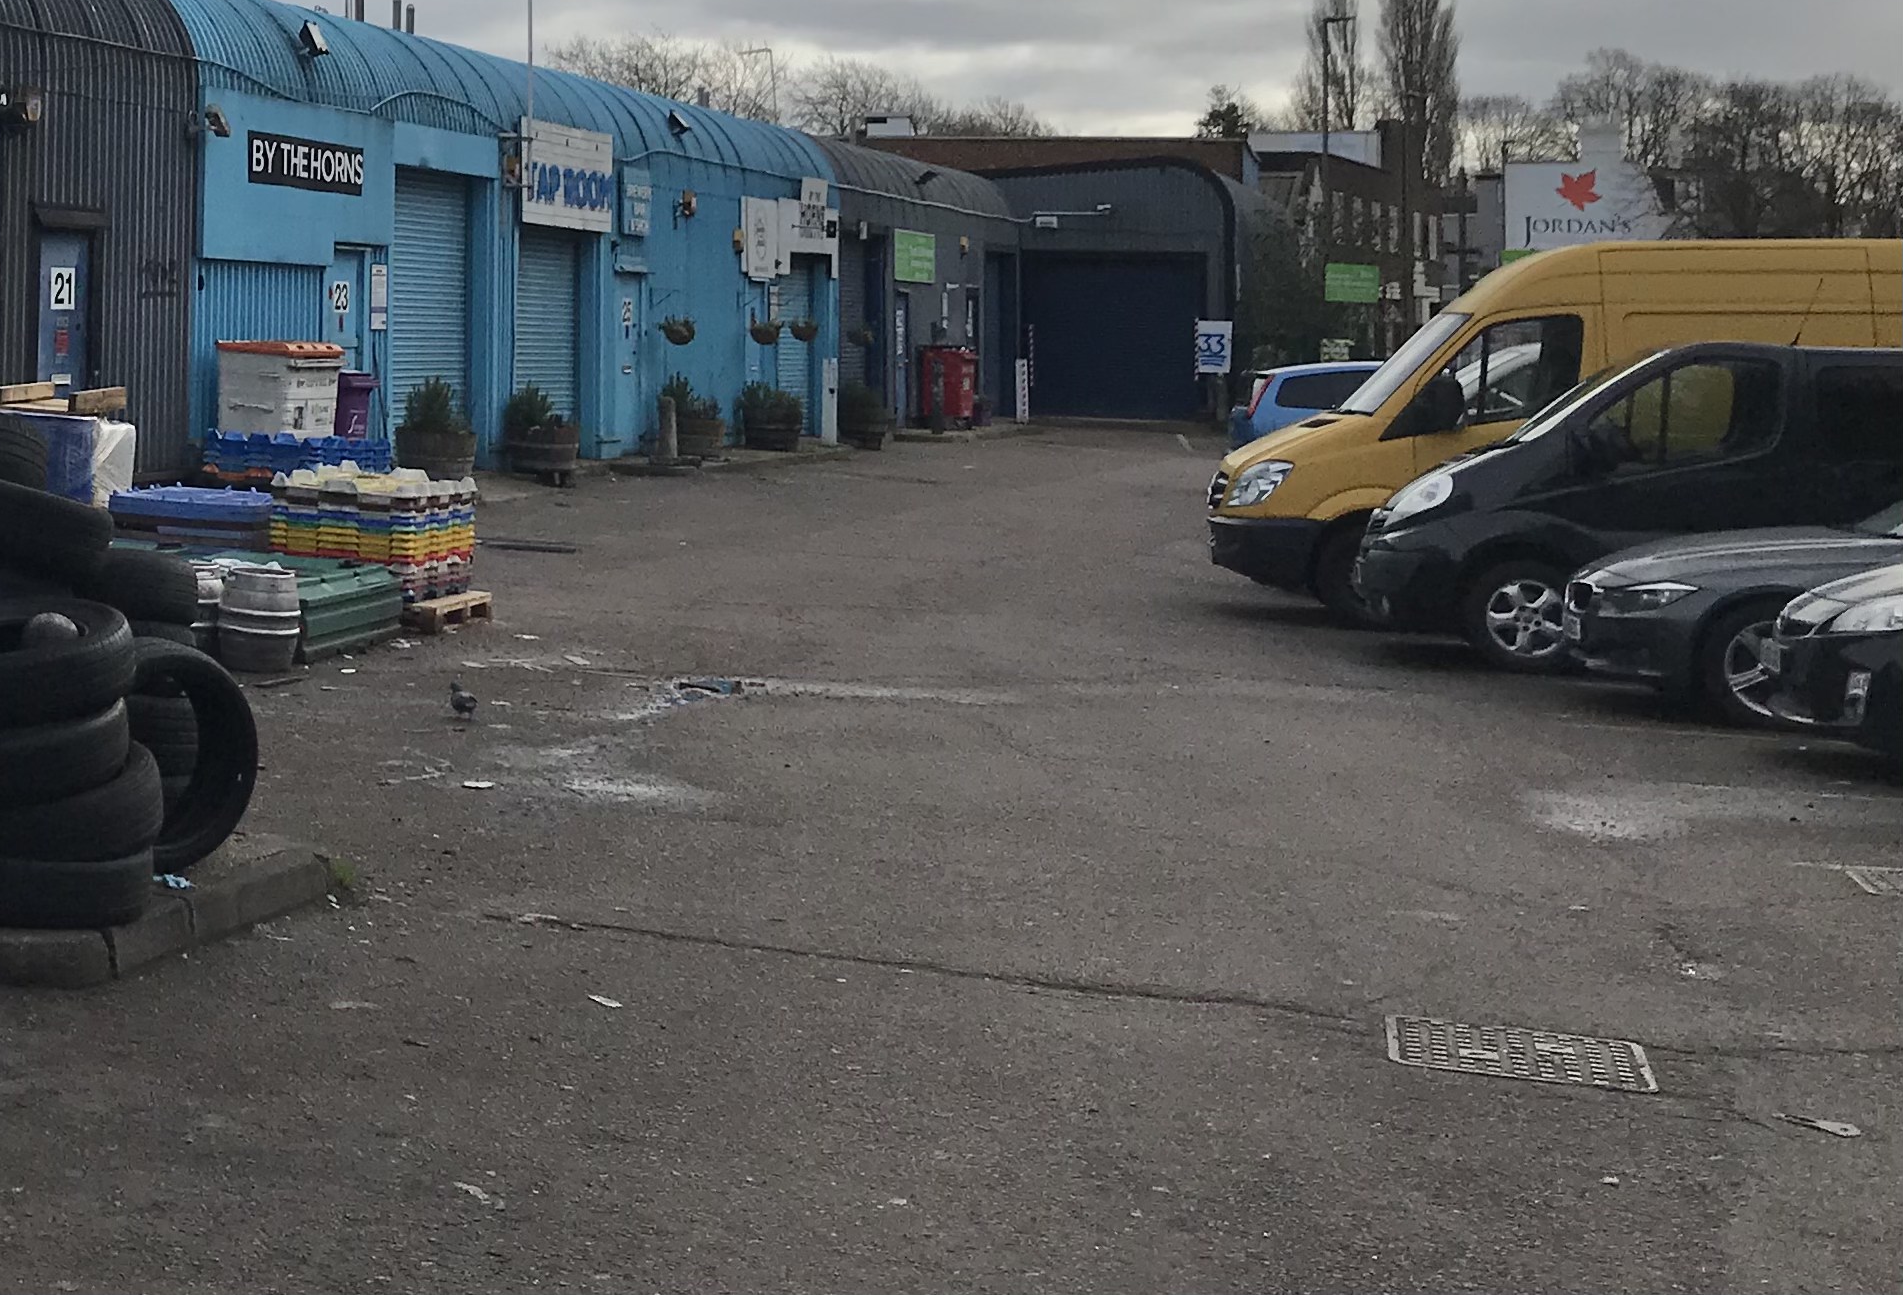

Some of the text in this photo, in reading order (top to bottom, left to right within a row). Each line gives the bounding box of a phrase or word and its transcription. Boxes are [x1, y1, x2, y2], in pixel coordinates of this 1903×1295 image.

[252, 139, 363, 185] BY THE HORNS
[525, 162, 560, 205] TAP
[563, 168, 614, 213] ROOM
[54, 272, 72, 305] 21
[334, 283, 348, 310] 23
[1198, 334, 1225, 354] 33
